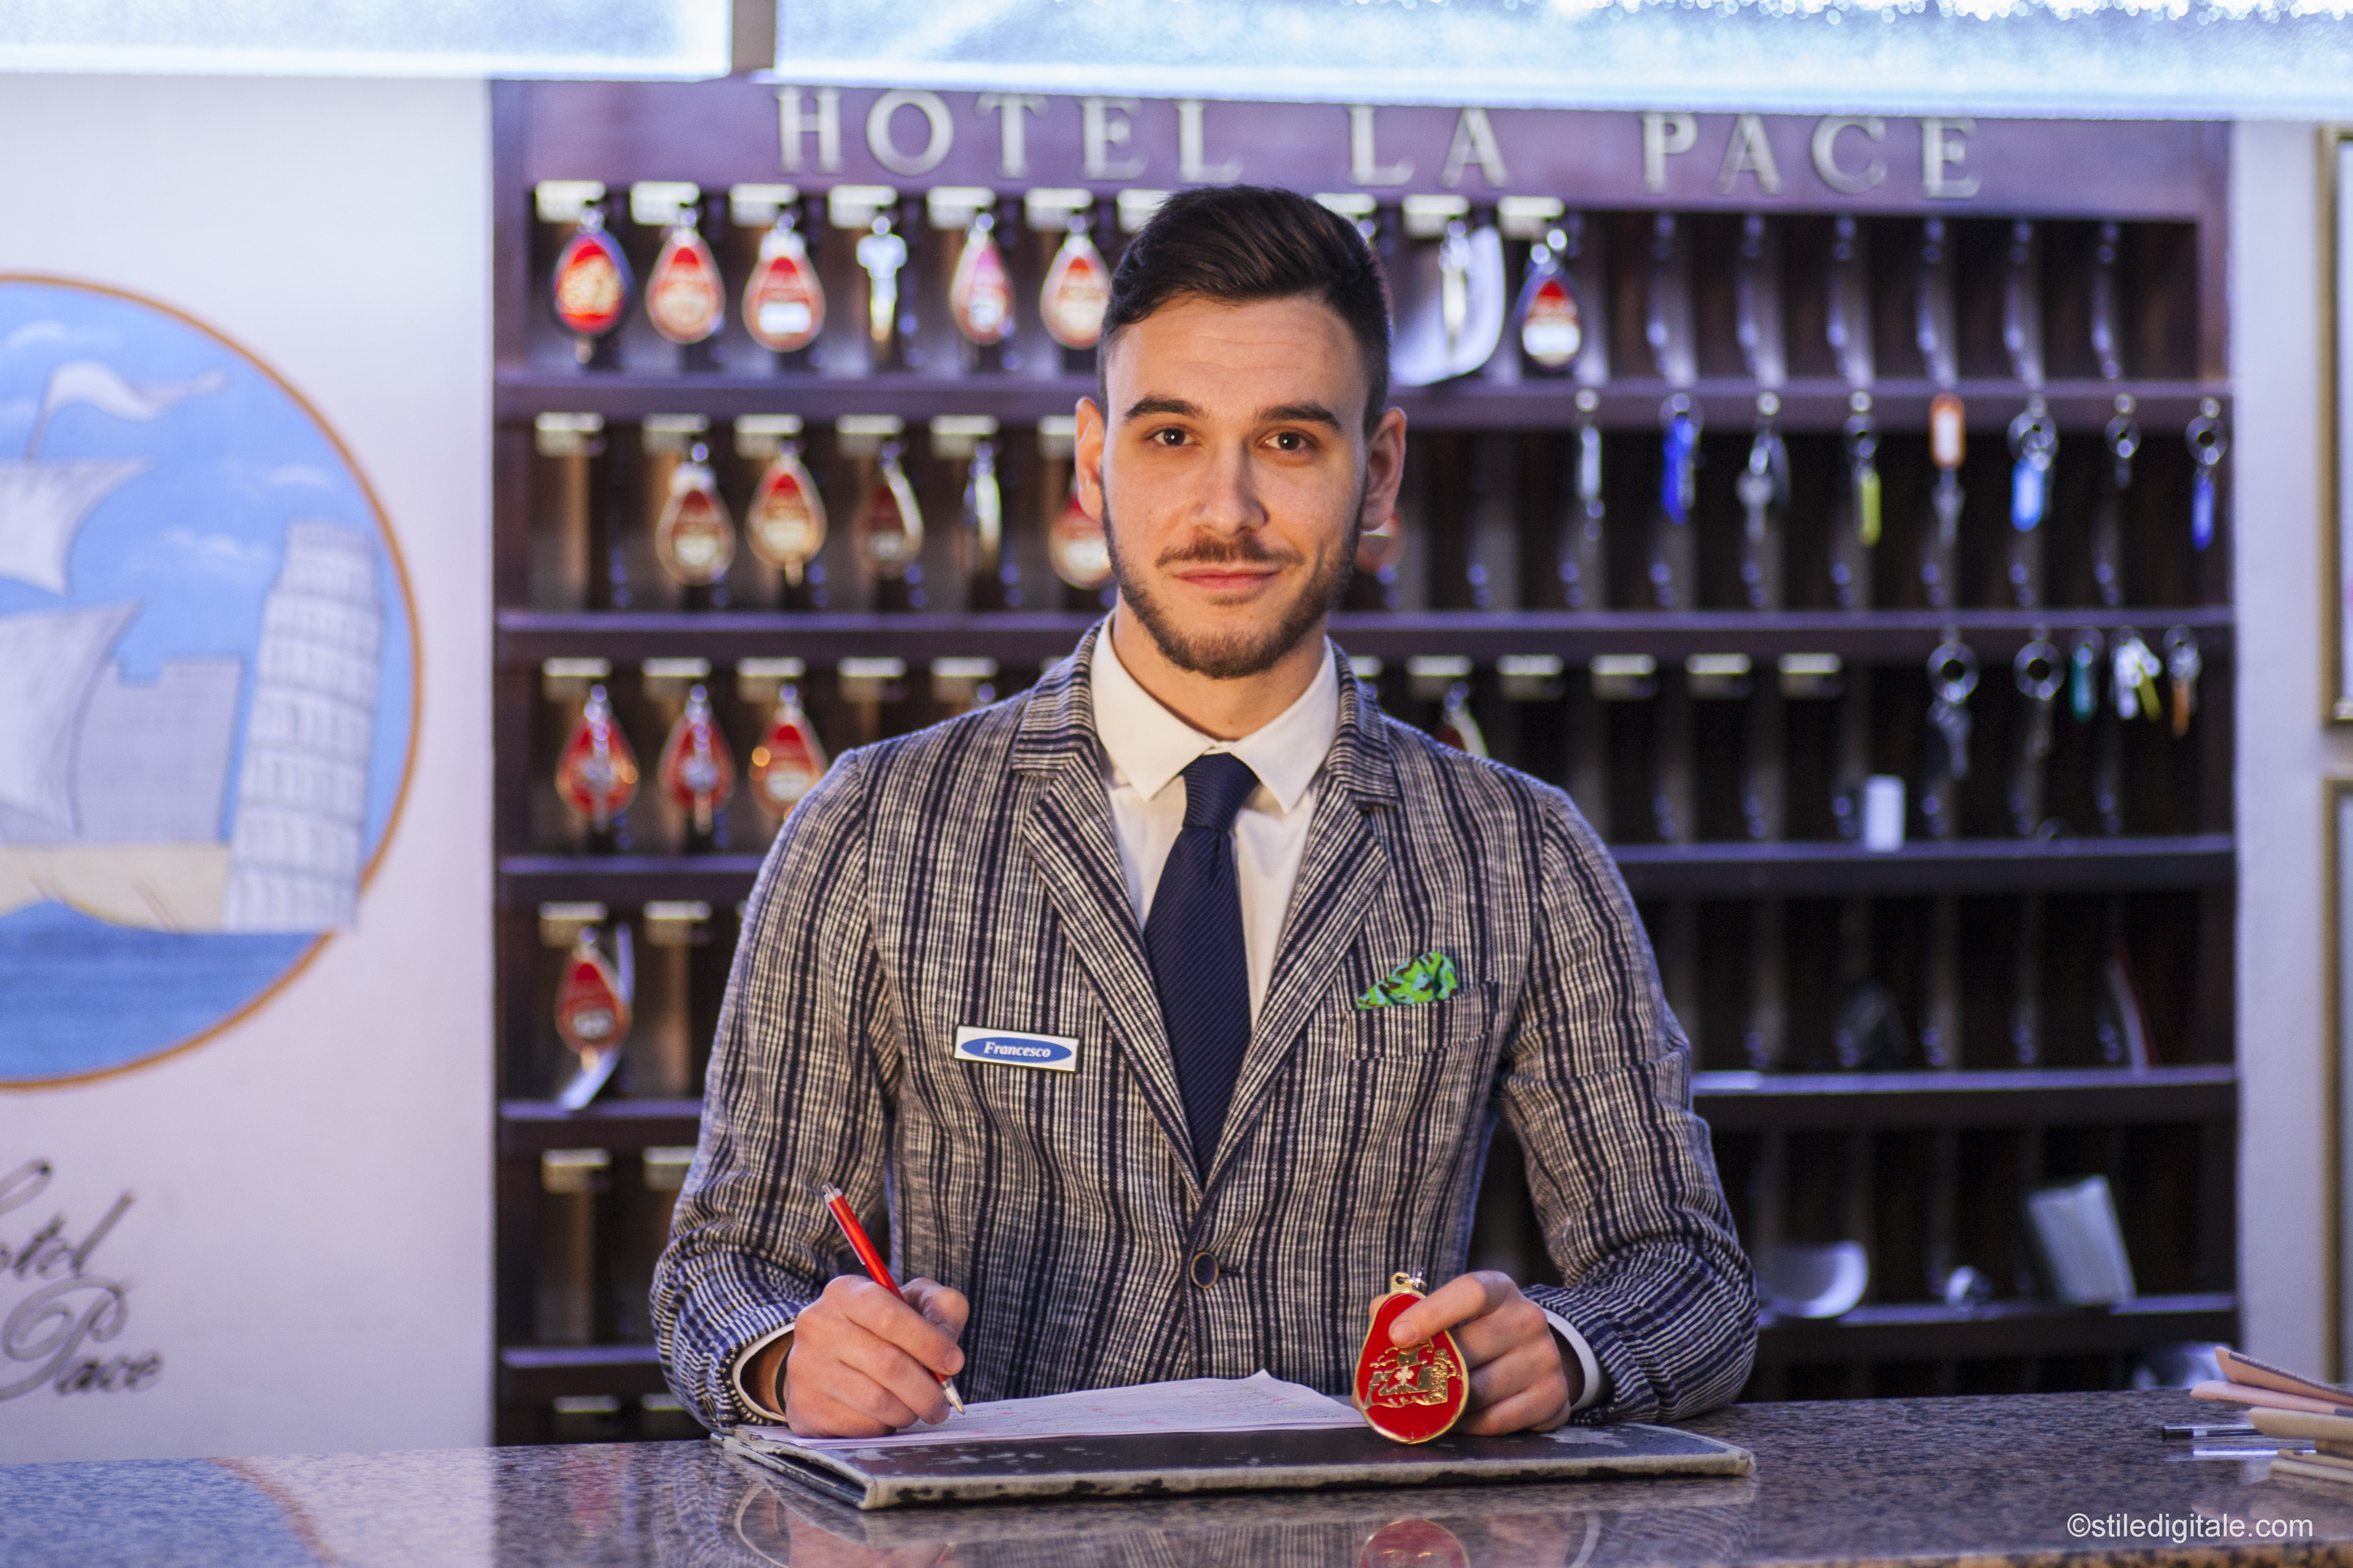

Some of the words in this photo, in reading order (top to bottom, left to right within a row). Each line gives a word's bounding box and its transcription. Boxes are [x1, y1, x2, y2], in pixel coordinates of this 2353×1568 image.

[774, 84, 1244, 184] HOTEL
[1347, 103, 1511, 189] LA
[1637, 109, 1982, 200] PACE
[983, 1042, 1052, 1058] Francesco
